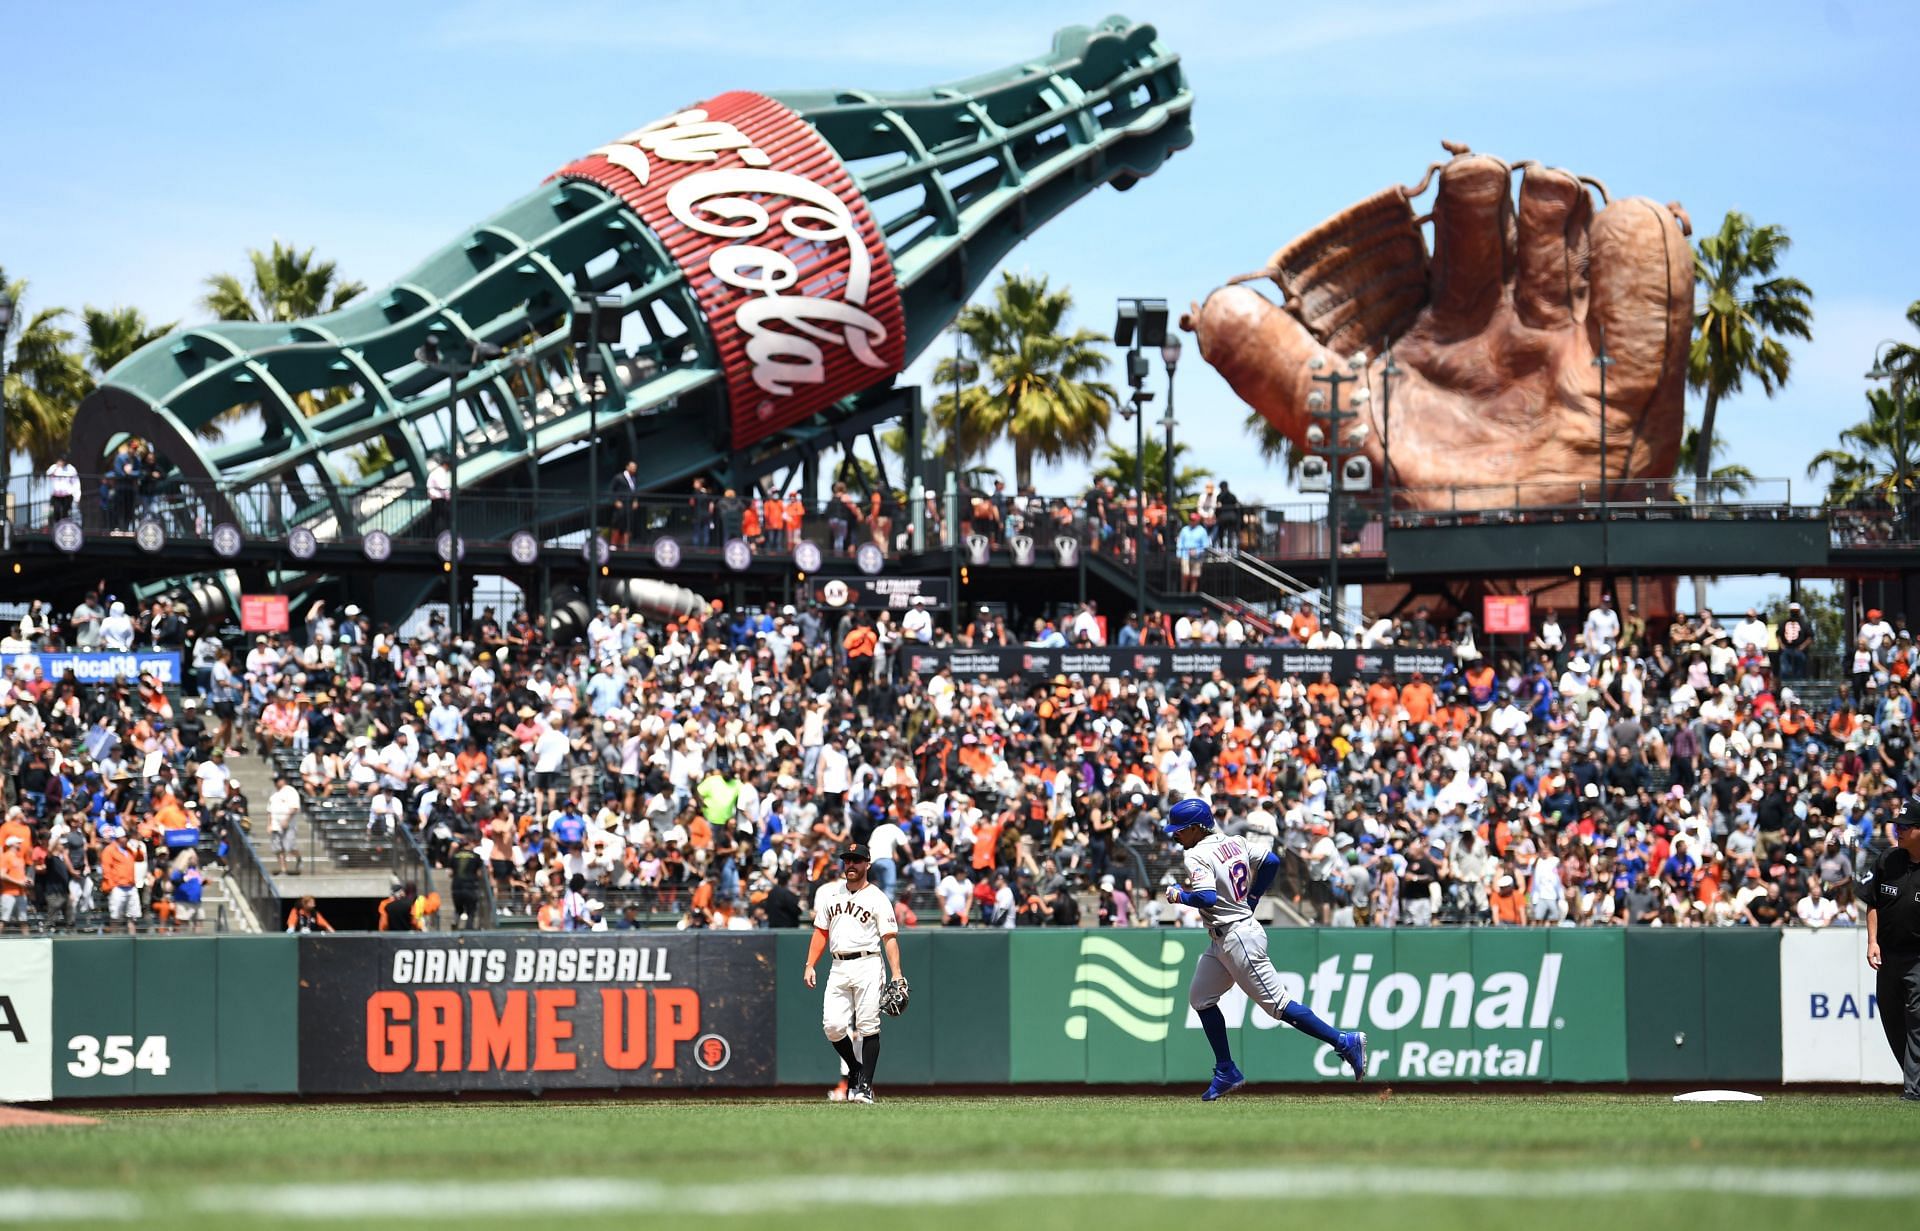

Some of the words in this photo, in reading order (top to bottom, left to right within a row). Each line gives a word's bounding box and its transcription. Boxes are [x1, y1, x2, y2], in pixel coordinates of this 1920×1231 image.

[1228, 860, 1248, 903] 12
[393, 949, 507, 983] GIANTS
[513, 948, 672, 982] BASEBALL
[367, 989, 577, 1073] GAME
[600, 988, 700, 1070] UP
[67, 1035, 171, 1078] 354
[1398, 1039, 1544, 1077] Rental
